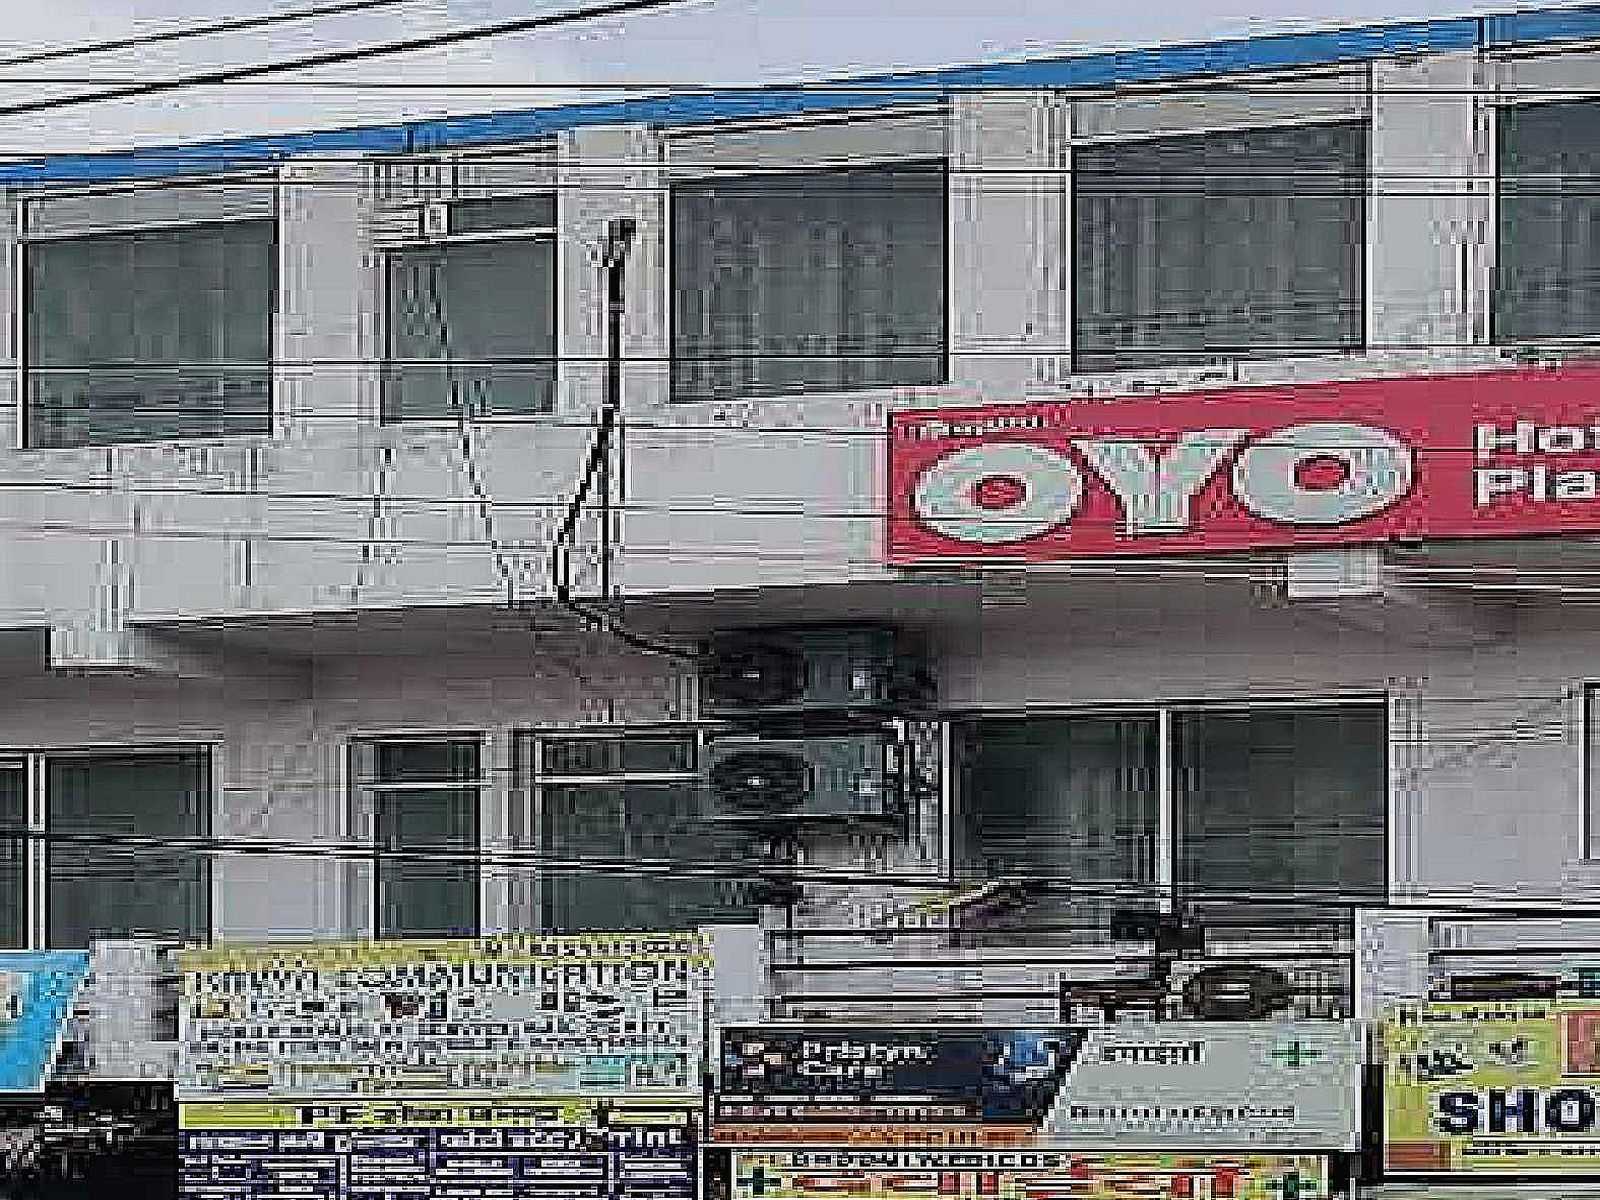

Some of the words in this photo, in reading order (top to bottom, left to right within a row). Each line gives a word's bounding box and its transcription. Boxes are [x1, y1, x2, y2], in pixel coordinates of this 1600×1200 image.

[911, 424, 1415, 545] OYO
[800, 1040, 930, 1064] Pristyn
[798, 1061, 884, 1078] Care
